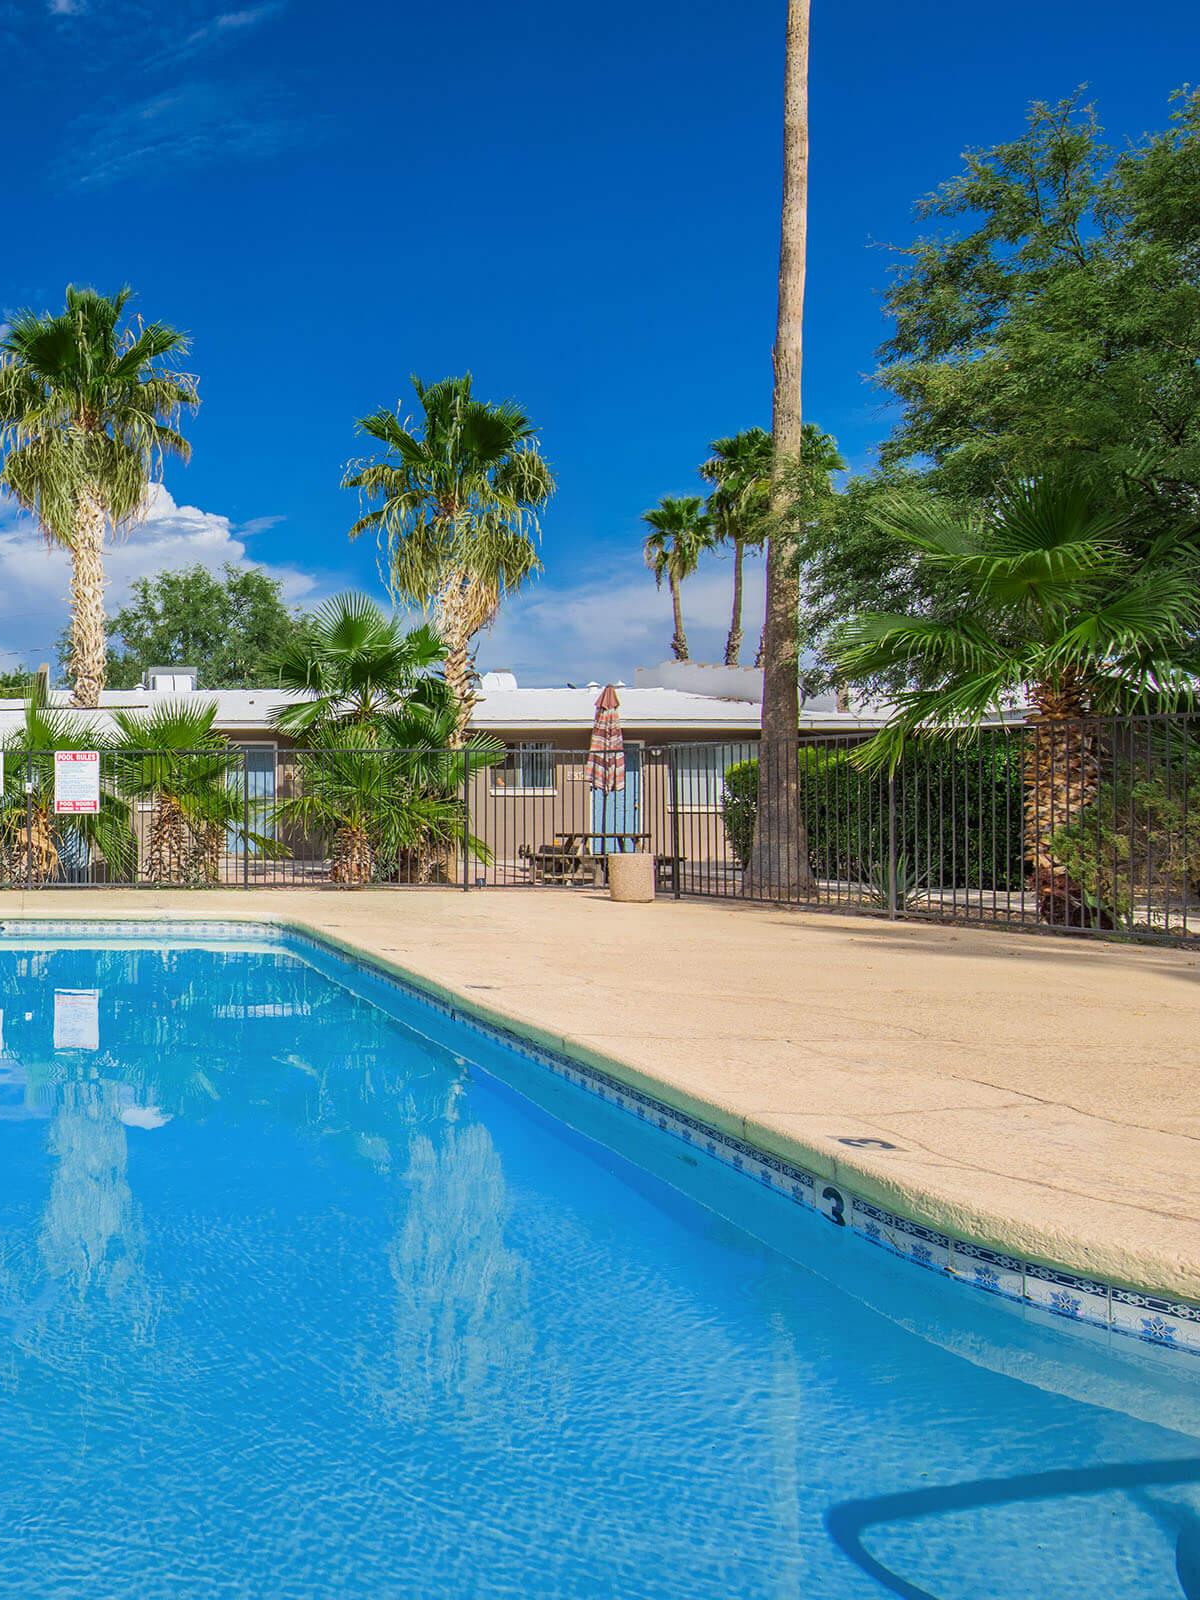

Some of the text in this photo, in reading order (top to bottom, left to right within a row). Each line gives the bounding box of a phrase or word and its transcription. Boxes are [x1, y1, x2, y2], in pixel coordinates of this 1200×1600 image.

[58, 753, 96, 761] POOL RULES
[822, 1186, 846, 1227] 3
